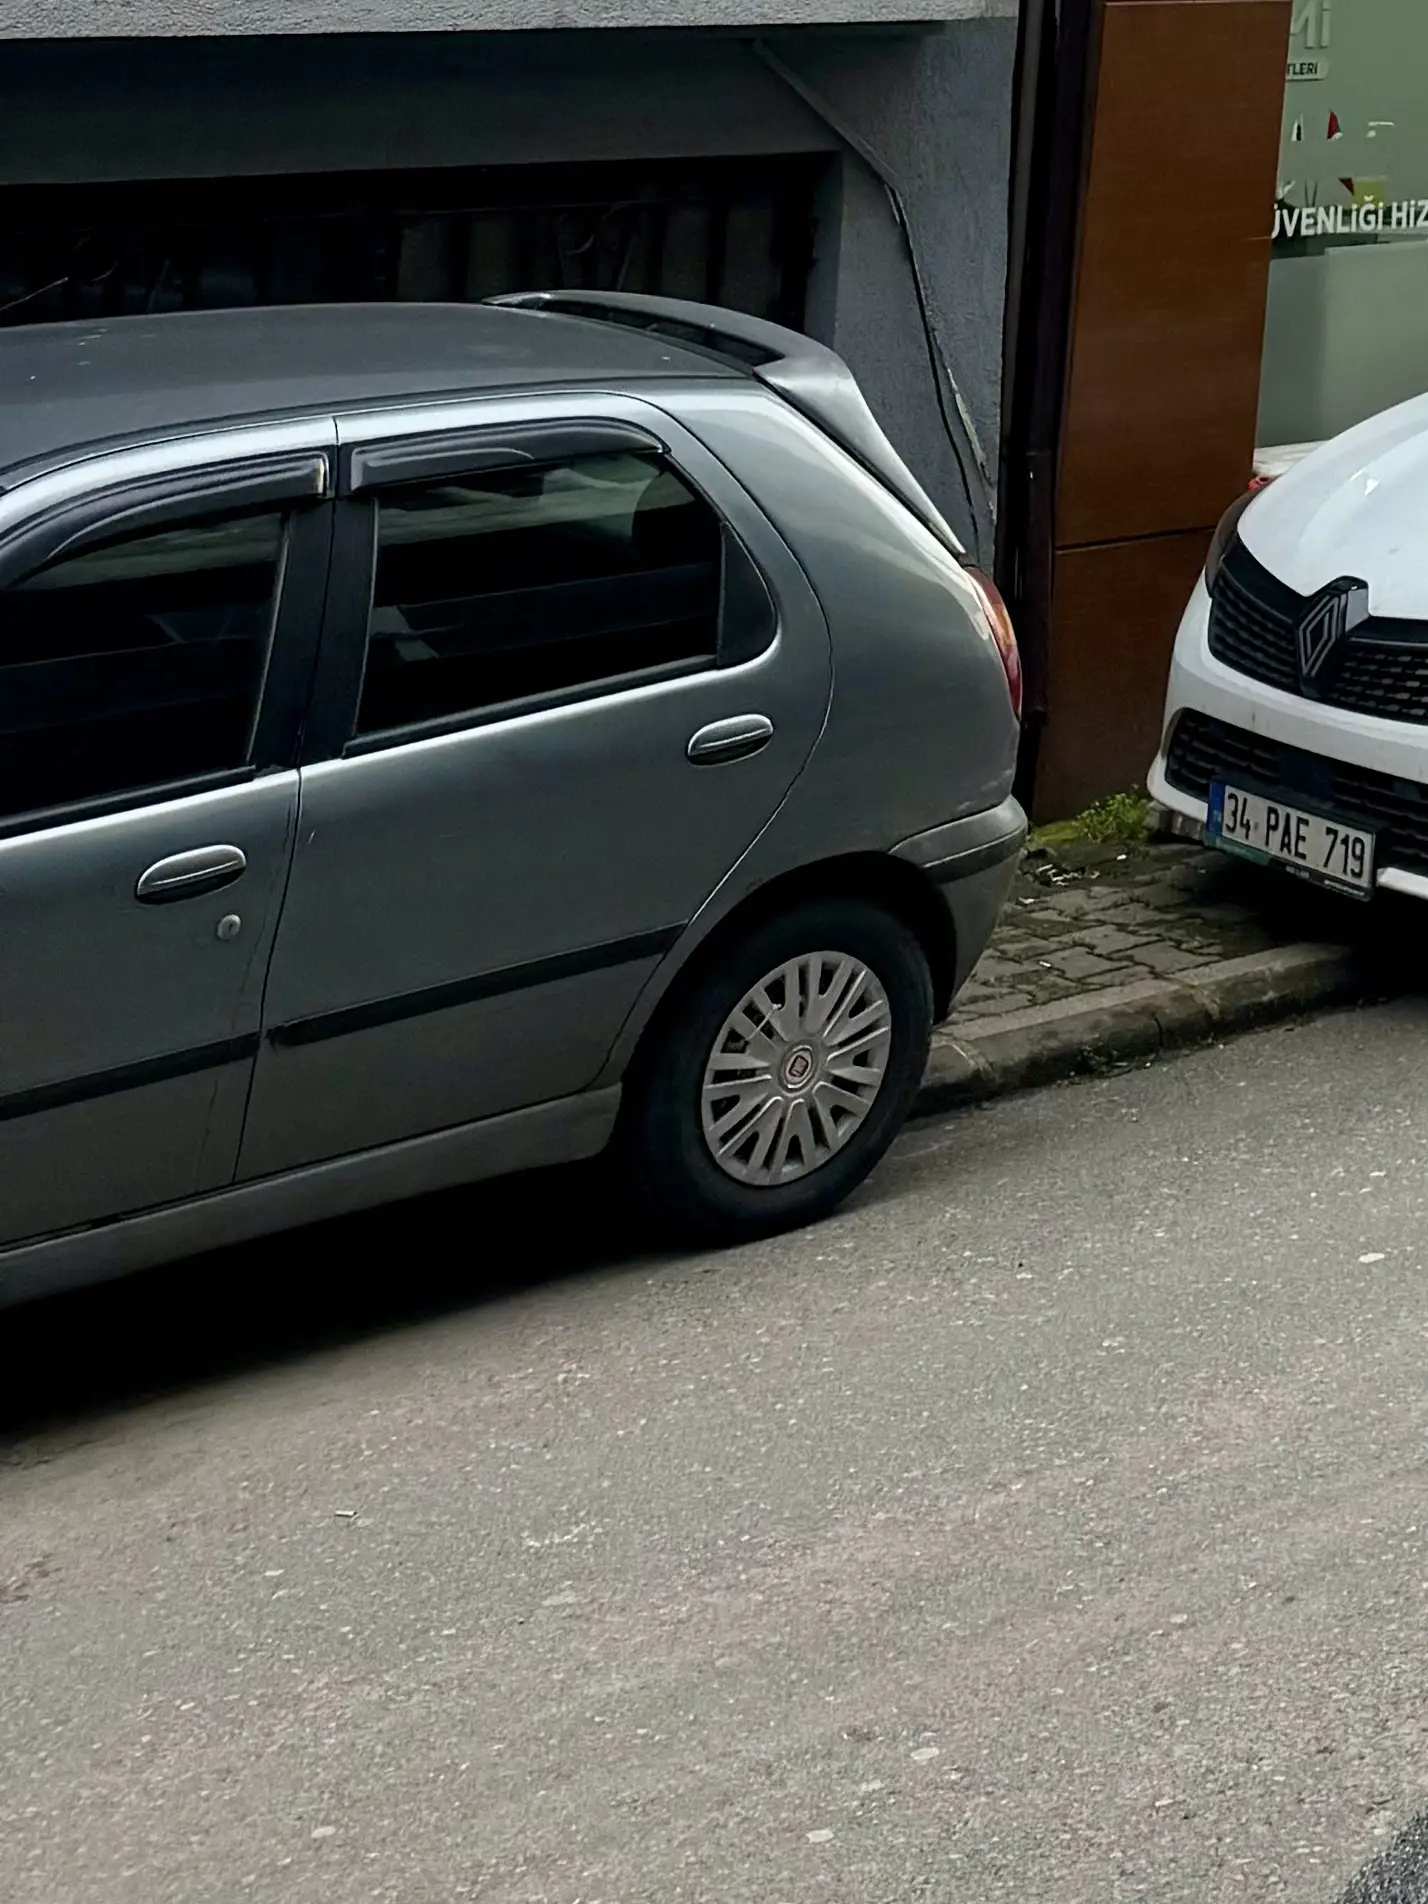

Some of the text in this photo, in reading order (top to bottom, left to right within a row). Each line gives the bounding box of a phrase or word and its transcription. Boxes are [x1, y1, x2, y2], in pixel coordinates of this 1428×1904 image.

[1225, 793, 1251, 840] 34
[1265, 806, 1309, 860] PAE
[1323, 826, 1365, 878] 719
